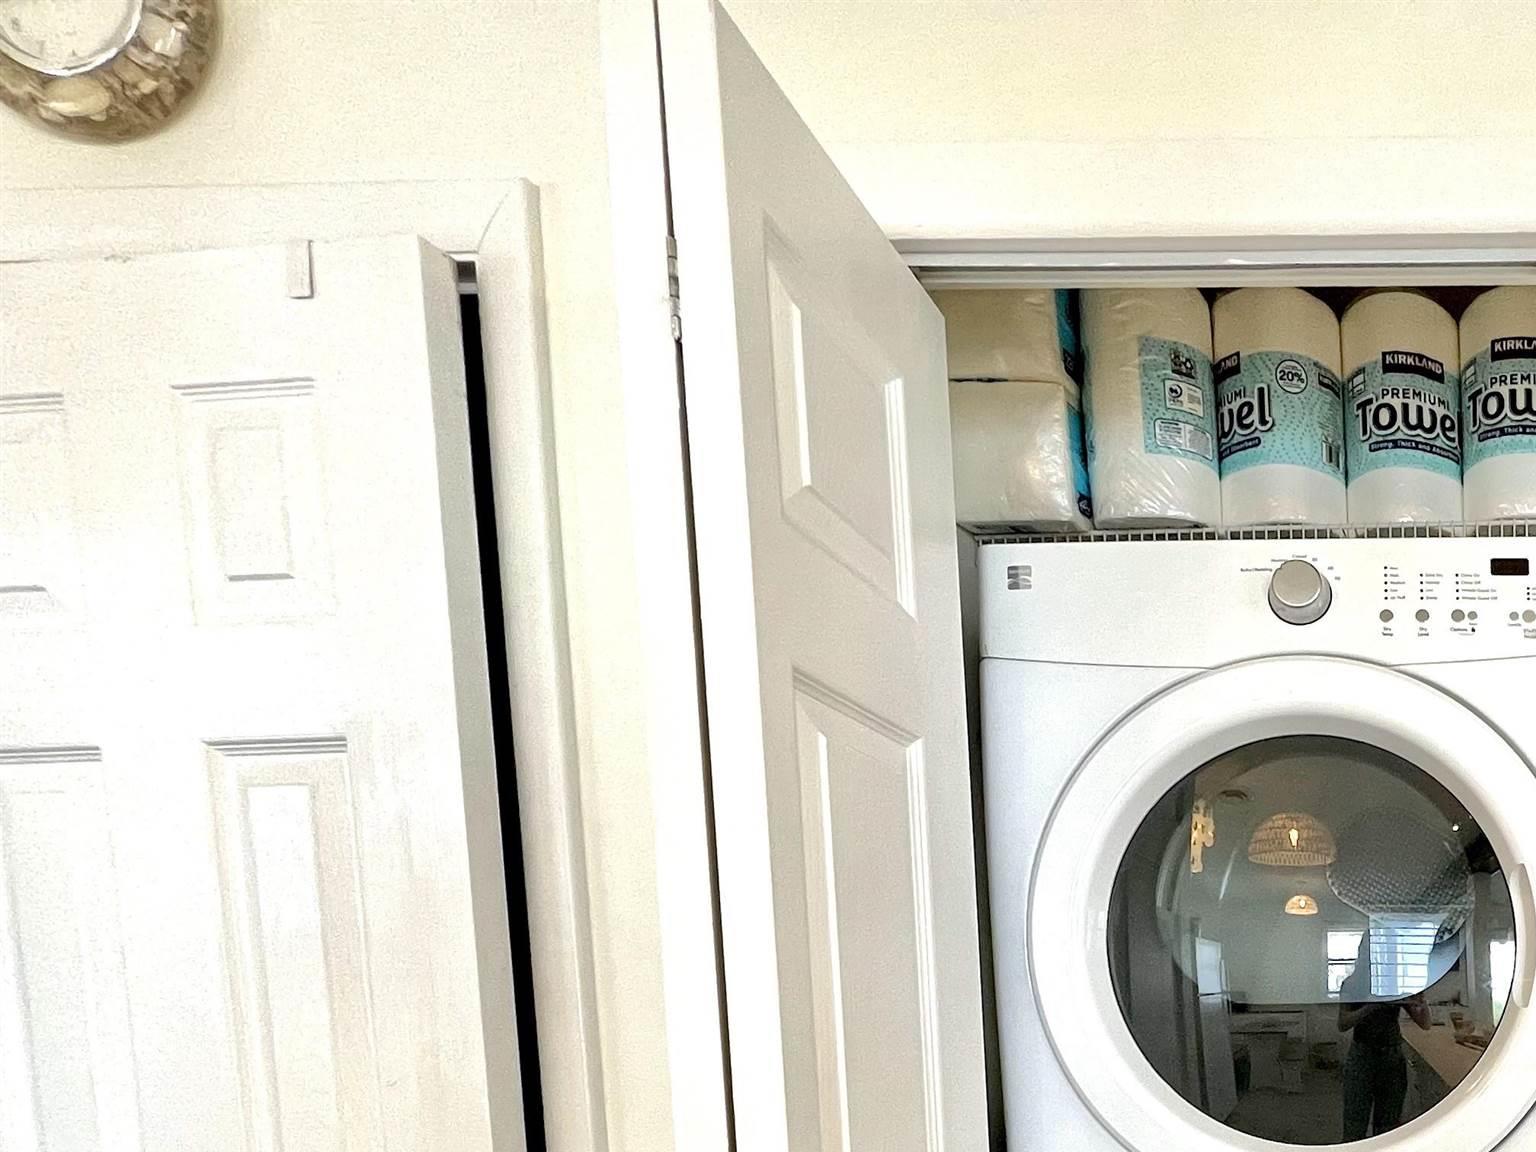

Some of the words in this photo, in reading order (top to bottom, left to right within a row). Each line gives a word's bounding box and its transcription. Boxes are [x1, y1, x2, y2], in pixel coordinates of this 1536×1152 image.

[1385, 353, 1443, 375] KIRKLAND
[1278, 369, 1306, 384] 20%
[1380, 387, 1449, 411] PREMIUM
